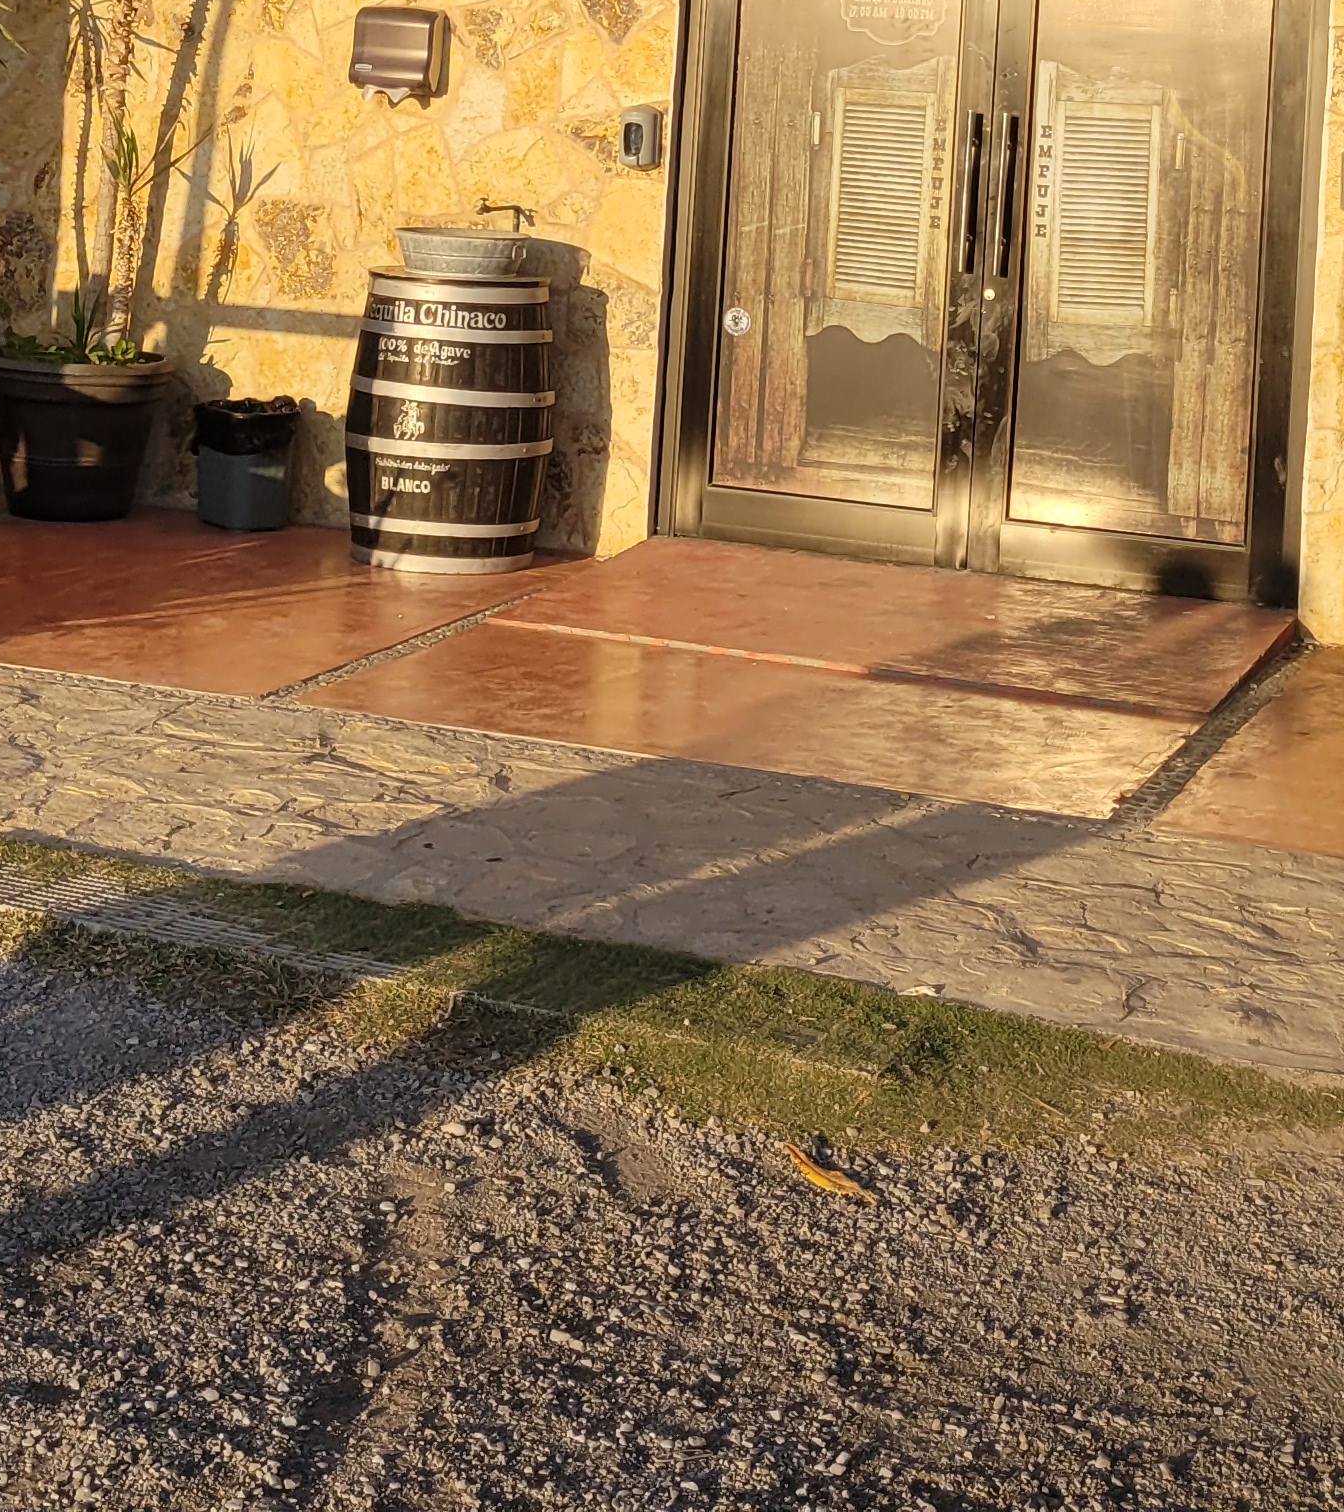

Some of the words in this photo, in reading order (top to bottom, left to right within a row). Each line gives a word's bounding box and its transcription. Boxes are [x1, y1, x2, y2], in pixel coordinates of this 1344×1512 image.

[929, 116, 946, 229] EMPUJE
[1035, 125, 1053, 238] EMPUJE
[369, 298, 416, 324] equila
[419, 303, 507, 329] Chinaco
[381, 476, 431, 494] BLANCO
